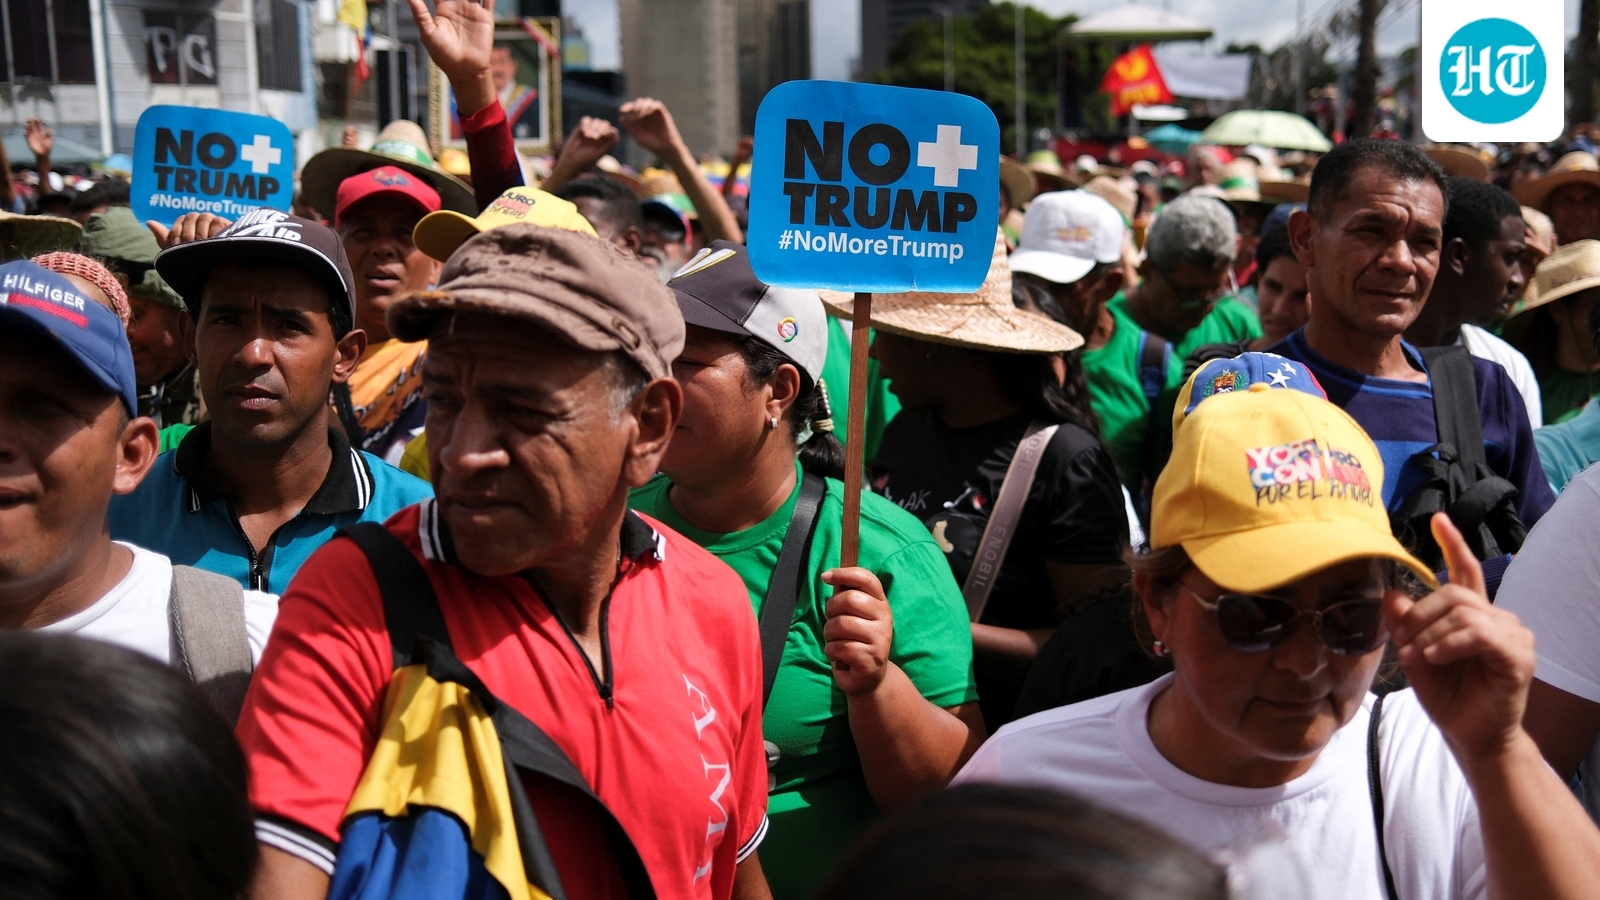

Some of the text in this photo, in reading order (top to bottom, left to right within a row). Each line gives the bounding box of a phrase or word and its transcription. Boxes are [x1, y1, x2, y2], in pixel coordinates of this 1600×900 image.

[153, 164, 280, 201] TRUMP
[782, 181, 978, 234] TRUMP
[778, 229, 964, 264] #NoMoreTrump
[3, 274, 86, 312] HILFIGER
[1256, 482, 1292, 507] POR
[1298, 479, 1323, 500] EL
